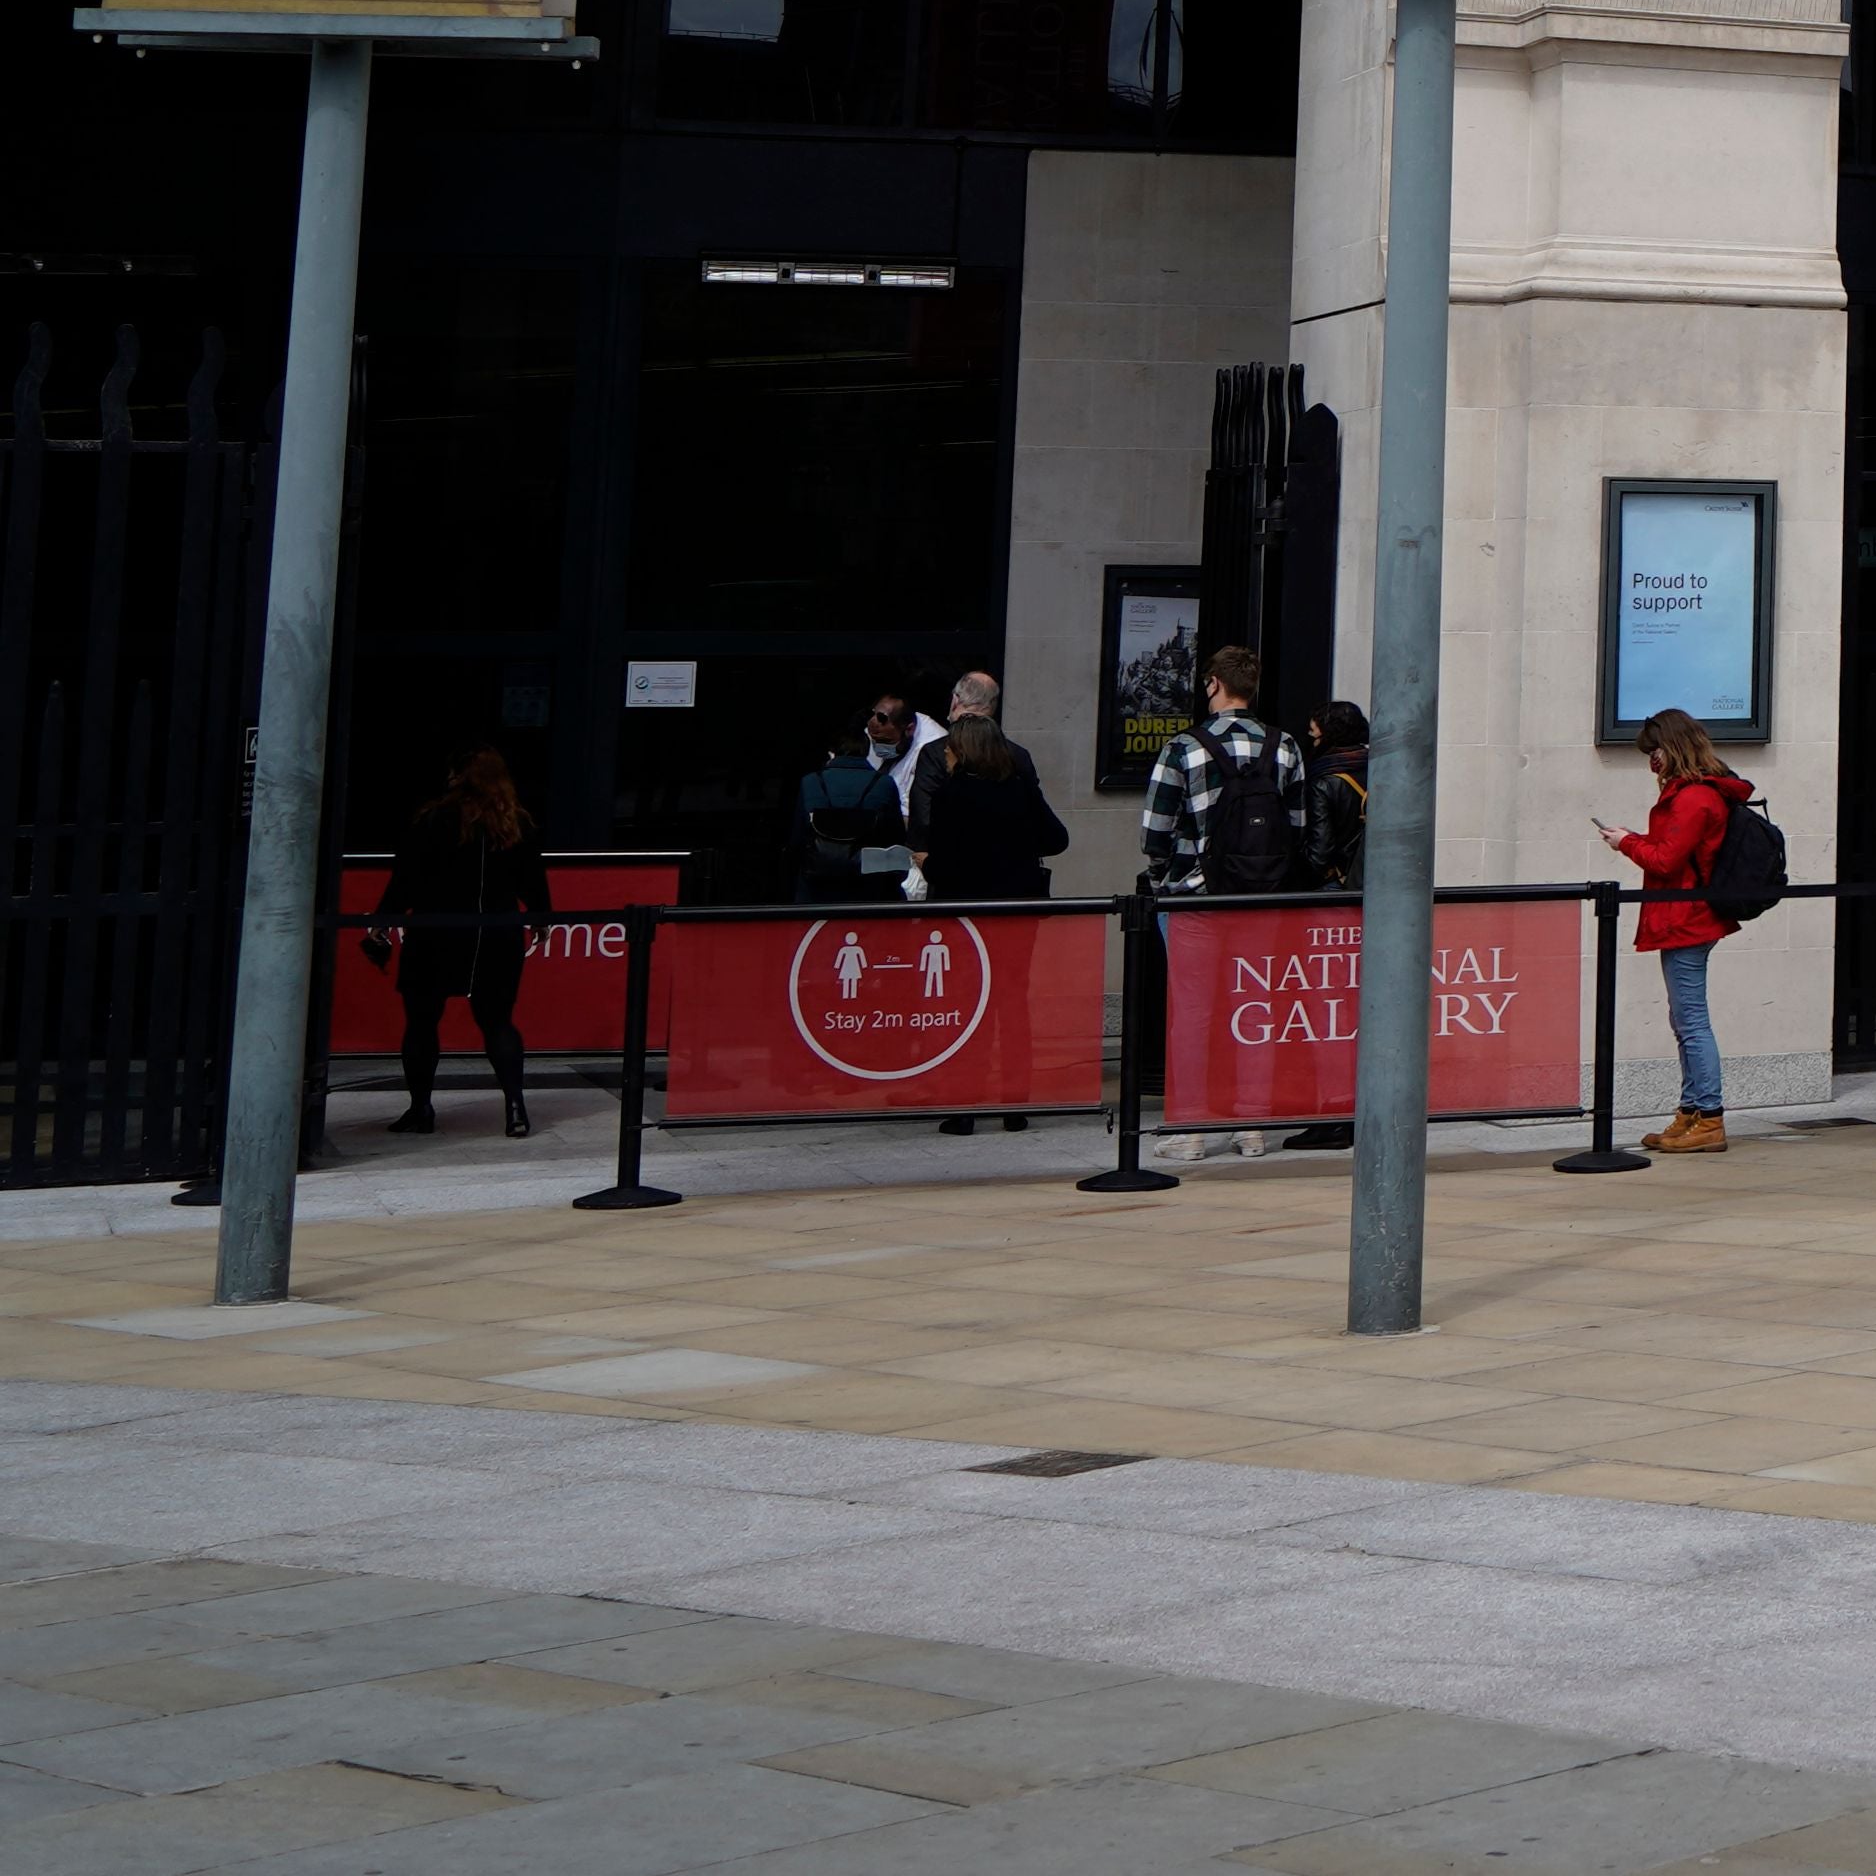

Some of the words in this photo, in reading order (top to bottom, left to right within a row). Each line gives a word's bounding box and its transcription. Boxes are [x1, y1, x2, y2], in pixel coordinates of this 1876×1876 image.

[1632, 573, 1684, 589] Proud
[1689, 573, 1708, 589] to
[1632, 594, 1703, 613] support
[1307, 926, 1362, 947] THE
[886, 955, 900, 963] 2m
[1231, 947, 1520, 994] NATINAL
[825, 1011, 866, 1033] Stay
[872, 1010, 903, 1028] 2m
[910, 1009, 961, 1030] apart
[1230, 992, 1519, 1046] GALRY
